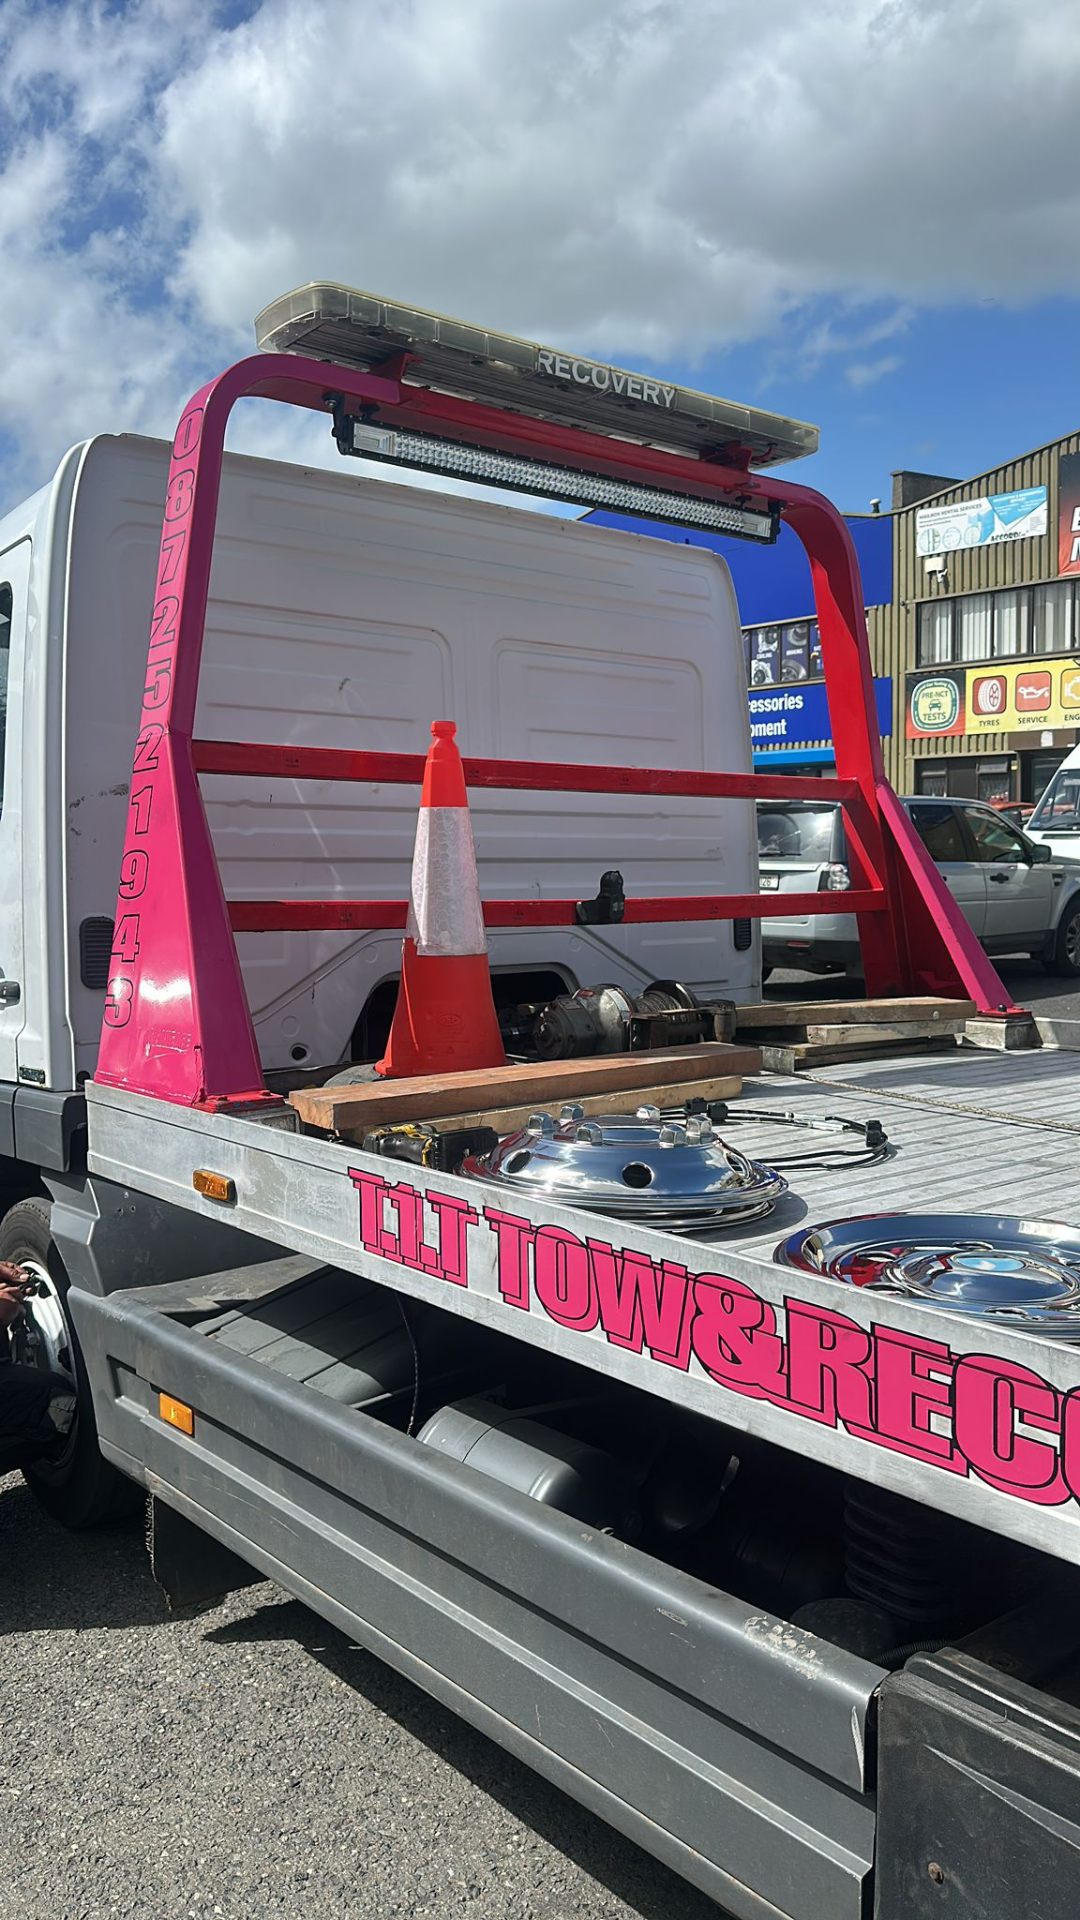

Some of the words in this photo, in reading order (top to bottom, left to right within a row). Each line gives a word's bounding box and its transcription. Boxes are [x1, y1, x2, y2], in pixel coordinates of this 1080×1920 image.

[537, 350, 676, 408] RECOVERY
[921, 690, 949, 699] PRE-NCT
[748, 693, 804, 713] essories
[103, 407, 205, 1029] 0872521943
[922, 712, 946, 721] TESTS
[1018, 715, 1048, 724] SERVICE
[979, 719, 1000, 727] TYRES
